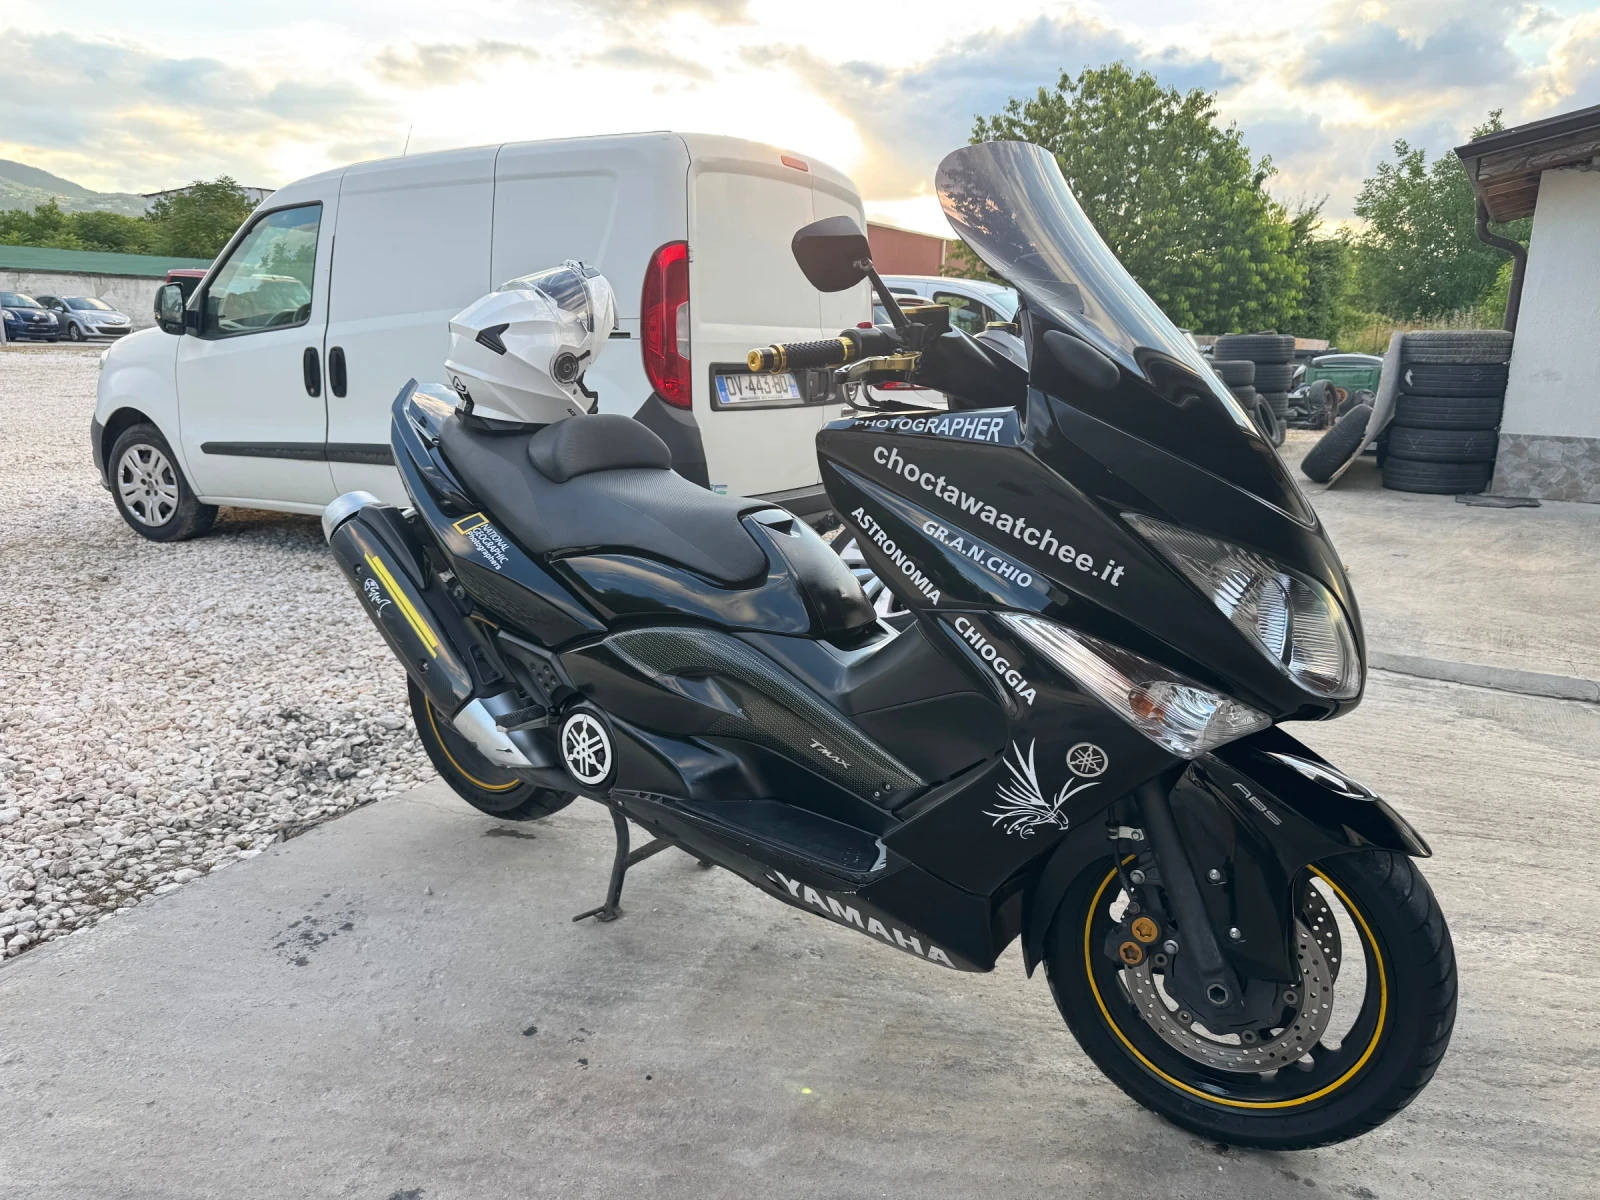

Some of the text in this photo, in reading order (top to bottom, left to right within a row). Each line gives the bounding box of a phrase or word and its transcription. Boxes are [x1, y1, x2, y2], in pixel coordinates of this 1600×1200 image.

[855, 417, 1004, 442] PHOTOGRAPHER
[481, 524, 510, 552] NATIONAL
[873, 445, 1125, 587] choctawaatchee.it
[466, 531, 501, 570] Photographers
[473, 527, 509, 564] GEOGRAPHIC
[851, 507, 941, 606] ASTRONOMIA
[922, 520, 1033, 588] GR.A.N.CHIO
[954, 617, 1037, 706] CHIOGGIA
[1232, 783, 1282, 825] ABS
[766, 869, 957, 969] YAMAHA
